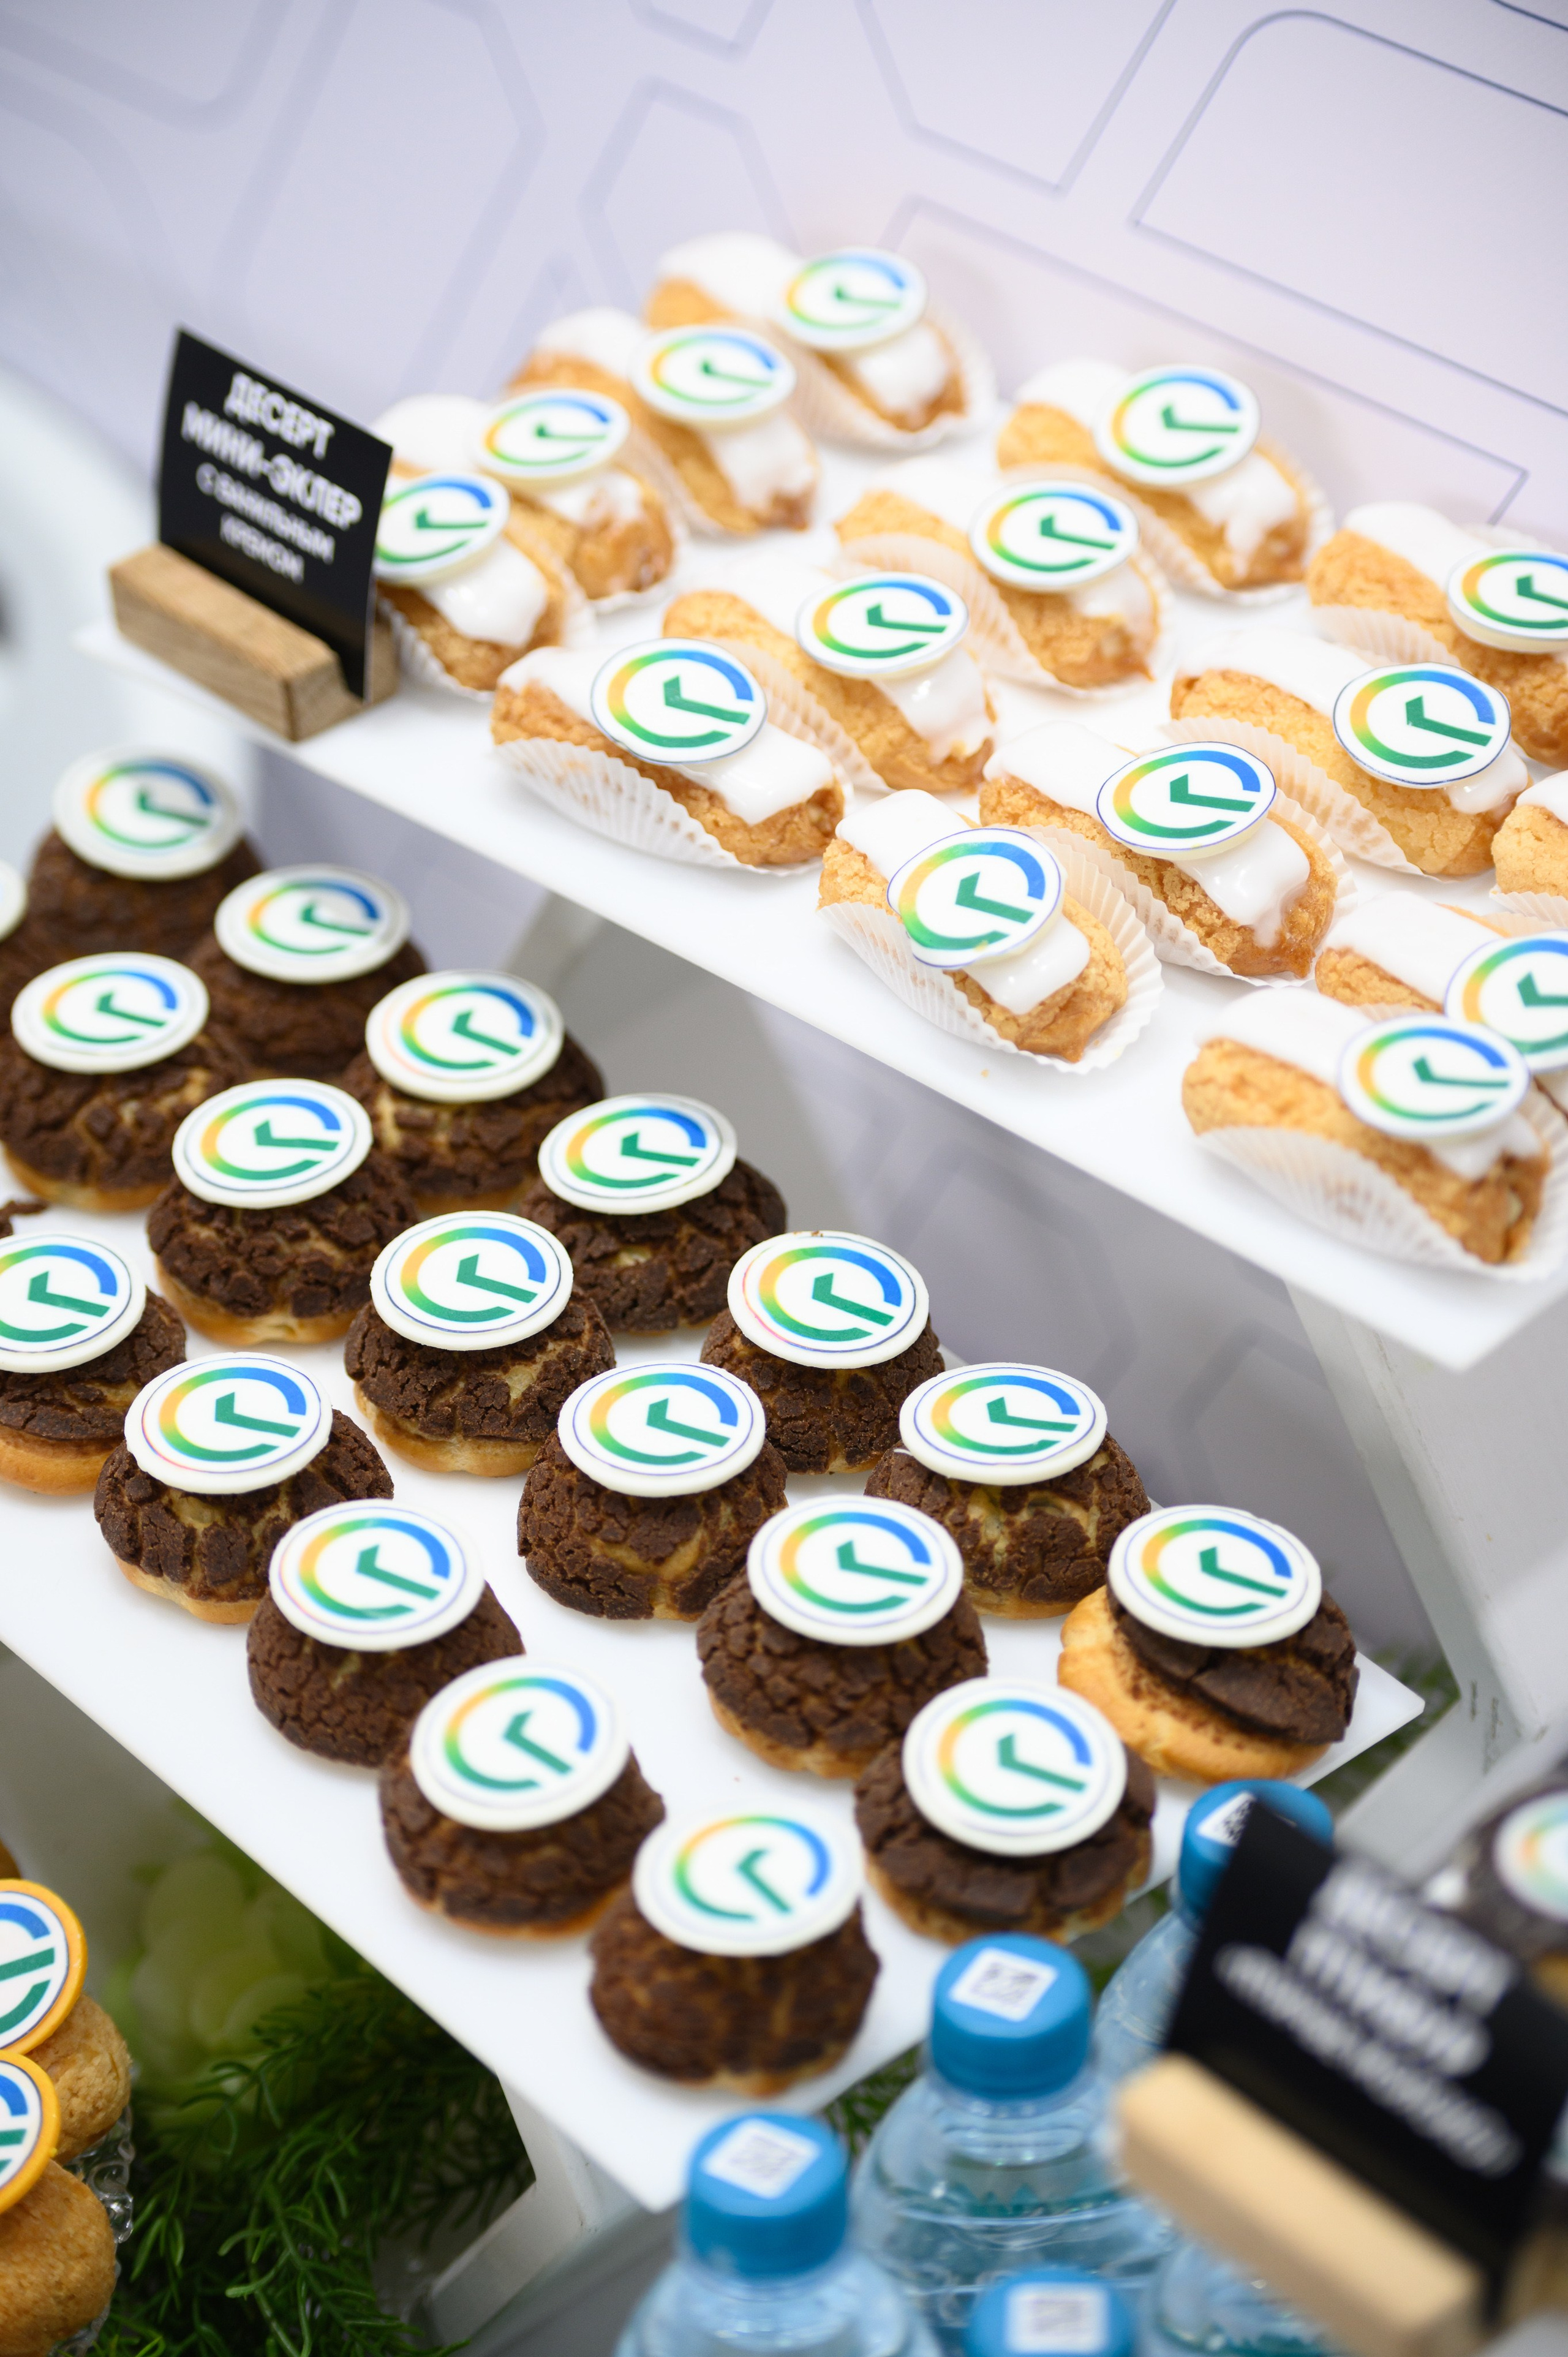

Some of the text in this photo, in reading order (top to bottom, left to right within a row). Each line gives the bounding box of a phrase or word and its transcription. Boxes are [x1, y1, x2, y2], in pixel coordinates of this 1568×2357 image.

[181, 401, 363, 530] МИНИ-ЭКЛЕР
[223, 371, 336, 460] ДЕСЕРТ
[195, 462, 335, 565] С ВАНИЛЬНЫМ
